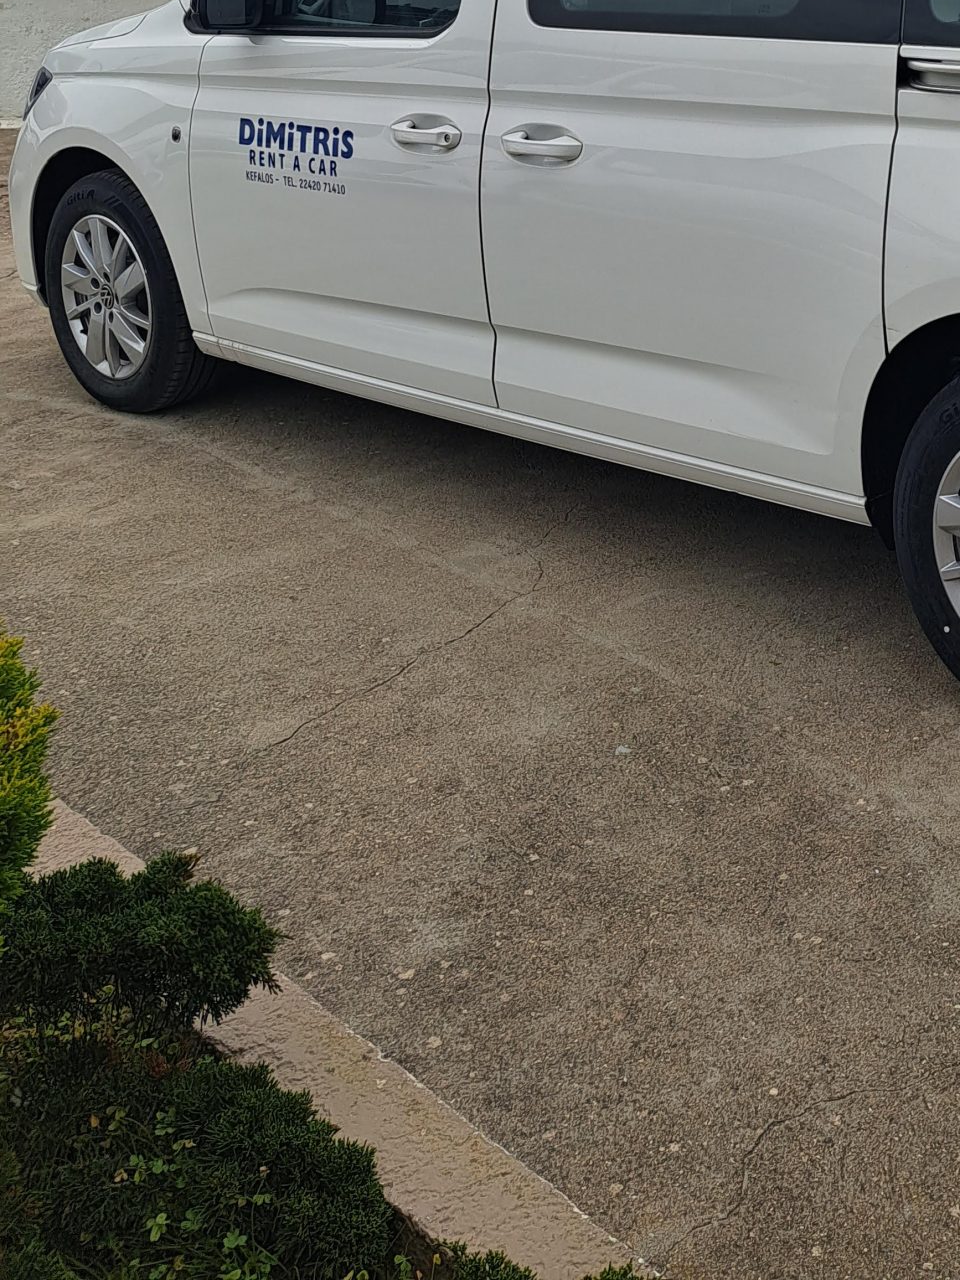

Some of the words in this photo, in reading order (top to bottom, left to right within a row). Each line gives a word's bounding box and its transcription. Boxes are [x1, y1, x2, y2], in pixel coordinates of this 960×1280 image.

[238, 117, 354, 159] DiMiTRiS
[249, 149, 286, 170] RENT
[293, 155, 301, 172] A
[308, 157, 338, 177] CAR
[246, 170, 274, 184] KEFALOS
[299, 178, 321, 191] 22420
[323, 182, 346, 195] 71410
